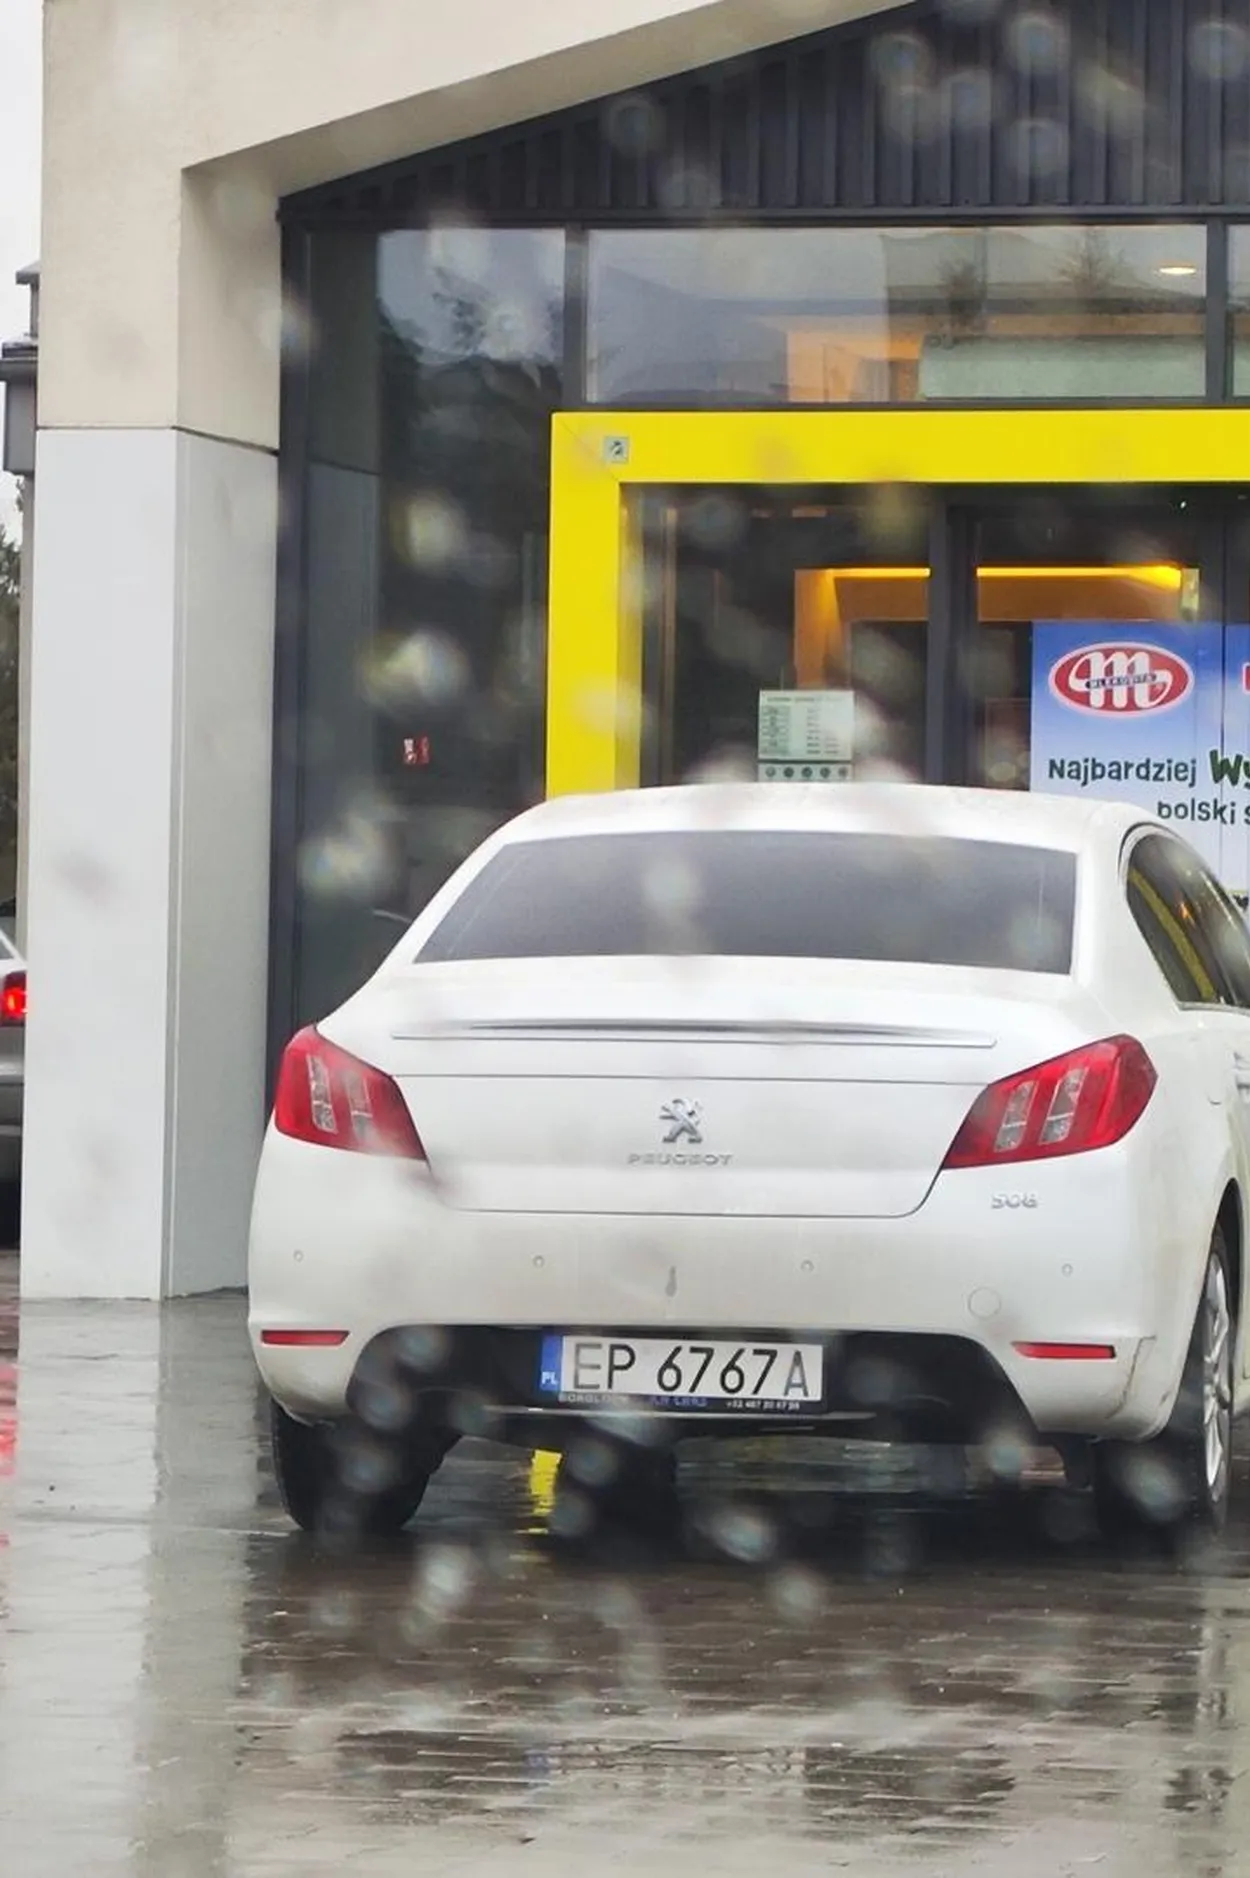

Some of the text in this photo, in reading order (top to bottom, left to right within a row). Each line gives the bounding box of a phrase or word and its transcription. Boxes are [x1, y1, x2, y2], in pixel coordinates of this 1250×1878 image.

[1049, 757, 1197, 788] Najbardziej
[627, 1152, 733, 1167] PEUGEOT
[541, 1371, 559, 1385] PL
[574, 1342, 809, 1398] EP 6767A
